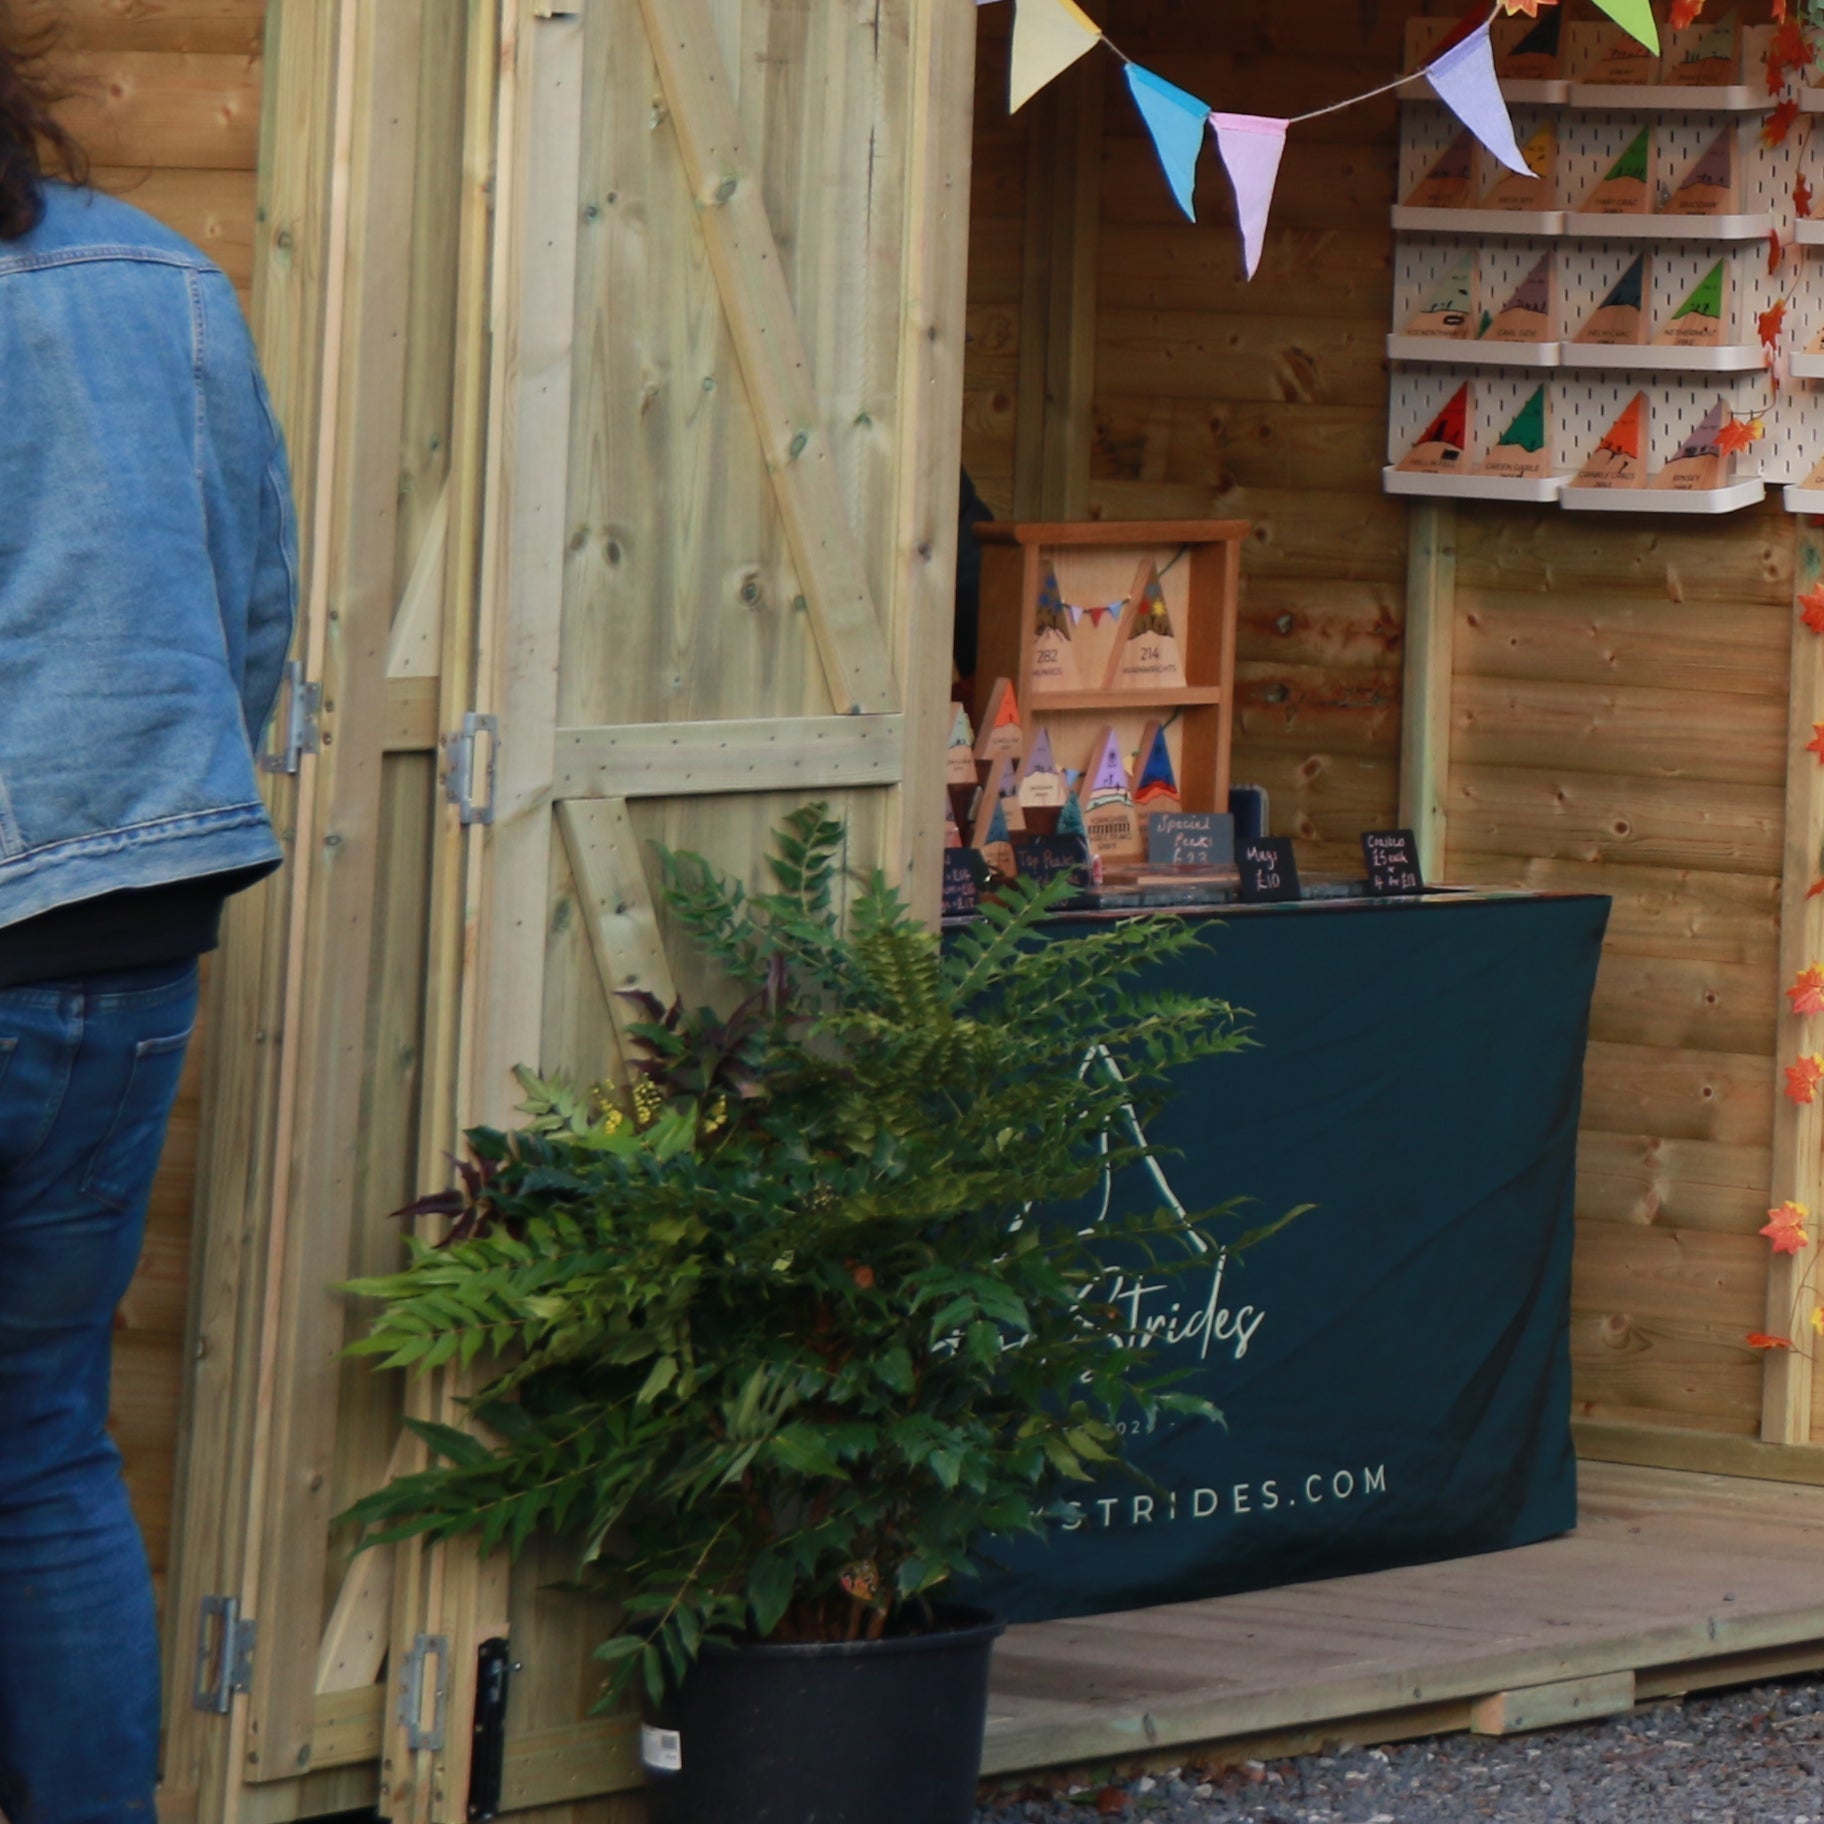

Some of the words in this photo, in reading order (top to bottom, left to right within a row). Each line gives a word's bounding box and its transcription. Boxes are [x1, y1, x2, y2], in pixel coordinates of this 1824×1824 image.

[1036, 649, 1058, 664] 282
[1140, 647, 1160, 661] 214
[1247, 846, 1279, 871] Mugs
[1256, 870, 1281, 891] £10
